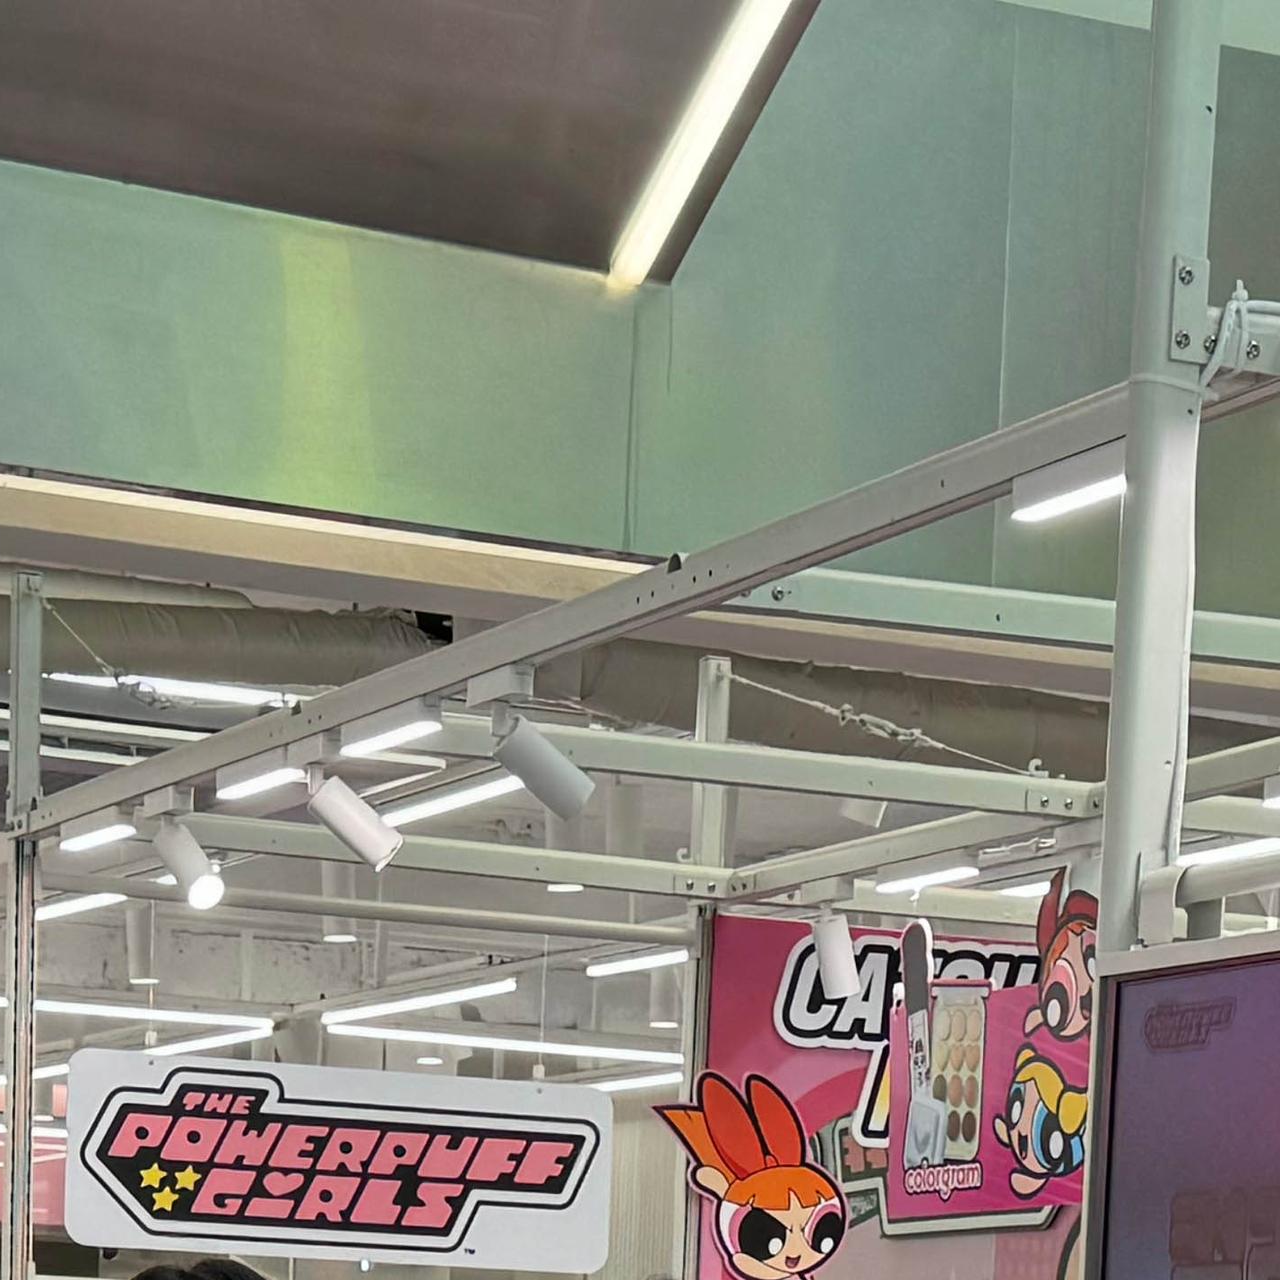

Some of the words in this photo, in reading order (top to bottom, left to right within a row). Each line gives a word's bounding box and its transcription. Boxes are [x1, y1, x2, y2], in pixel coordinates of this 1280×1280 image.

[182, 1091, 255, 1115] THE
[108, 1112, 577, 1186] POWERPUFF
[191, 1168, 463, 1229] GIRLS
[906, 1159, 981, 1198] colorgram
